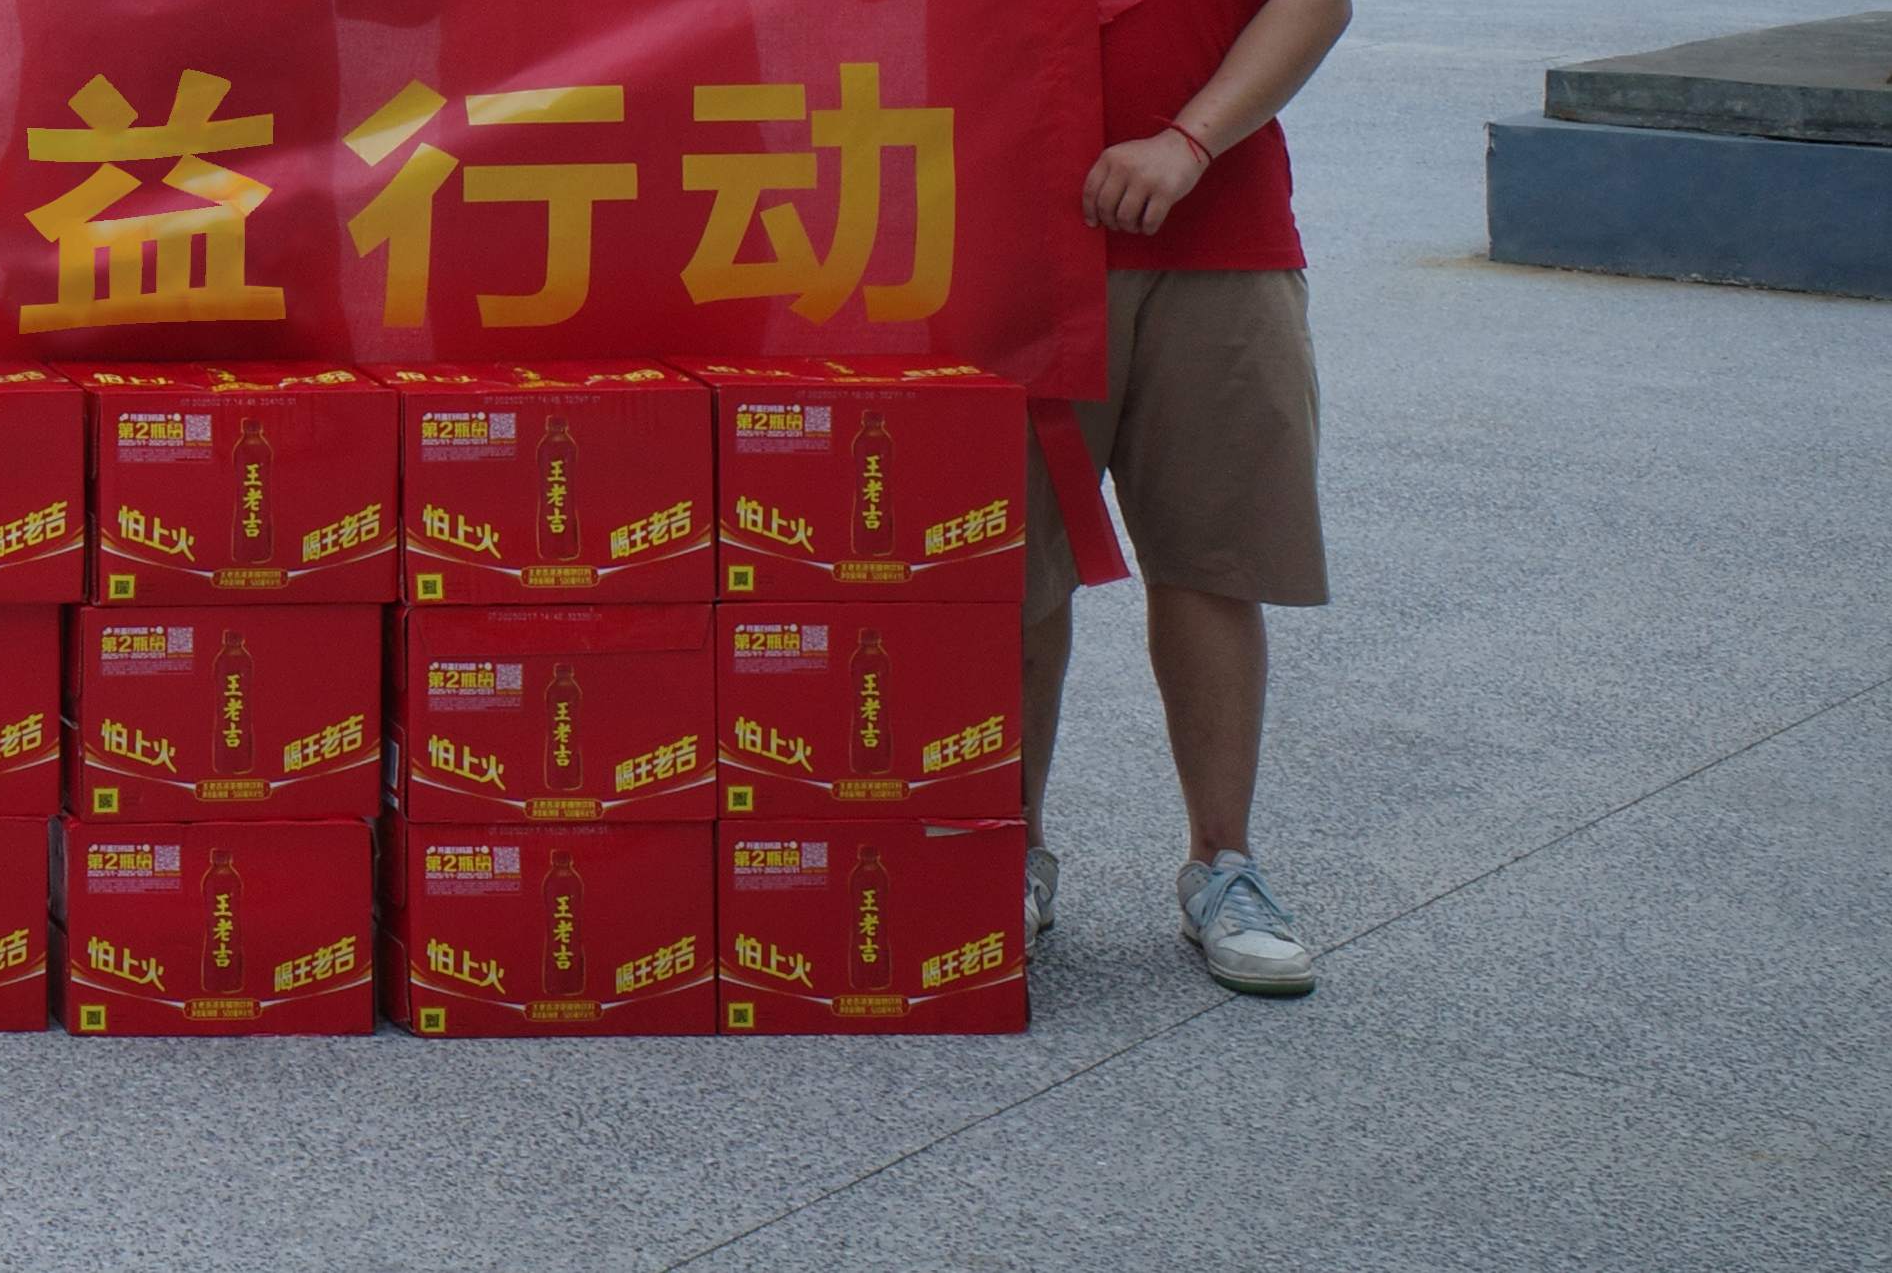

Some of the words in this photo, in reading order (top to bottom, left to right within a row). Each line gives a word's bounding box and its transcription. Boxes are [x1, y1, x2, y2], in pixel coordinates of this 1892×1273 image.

[243, 463, 263, 537] 王老吉
[547, 460, 566, 533] 王老吉
[862, 455, 883, 529] 王老吉
[118, 505, 195, 561] 怕上火
[302, 504, 381, 562] 喝王老吉
[423, 504, 501, 559] 怕上火
[610, 501, 692, 559] 喝王老吉
[736, 496, 814, 552] 怕上火
[925, 500, 1008, 555] 喝王老吉
[223, 674, 243, 747] 王老吉
[554, 702, 571, 766] 王老吉
[861, 674, 880, 747] 王老吉
[101, 719, 177, 772] 怕上火
[284, 715, 364, 772] 喝王老吉
[428, 735, 505, 789] 怕上火
[615, 735, 698, 792] 喝王老吉
[734, 716, 814, 773] 怕上火
[923, 716, 1004, 773] 喝王老吉
[214, 893, 233, 967] 王老吉
[554, 896, 573, 969] 王老吉
[860, 890, 879, 962] 王老吉
[88, 936, 164, 990] 怕上火
[275, 936, 356, 992] 喝王老吉
[427, 939, 505, 993] 怕上火
[616, 936, 695, 994] 喝王老吉
[735, 934, 812, 987] 怕上火
[922, 932, 1004, 988] 喝王老吉
